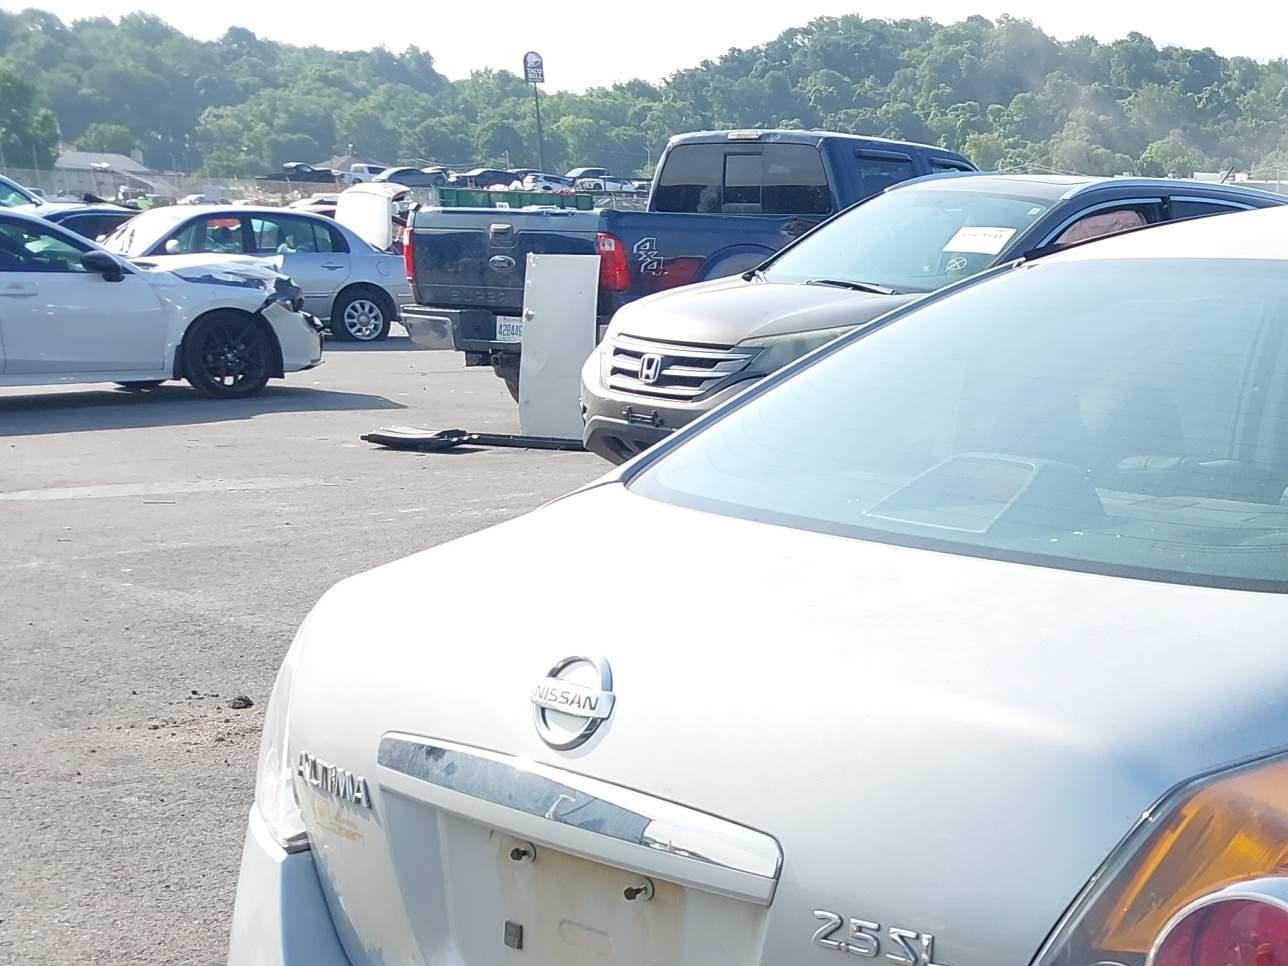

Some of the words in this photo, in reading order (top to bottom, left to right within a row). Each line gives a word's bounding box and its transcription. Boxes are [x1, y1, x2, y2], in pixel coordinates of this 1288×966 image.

[533, 683, 600, 711] NISSAN
[297, 750, 373, 809] ALTIMA
[811, 908, 881, 957] 2.5
